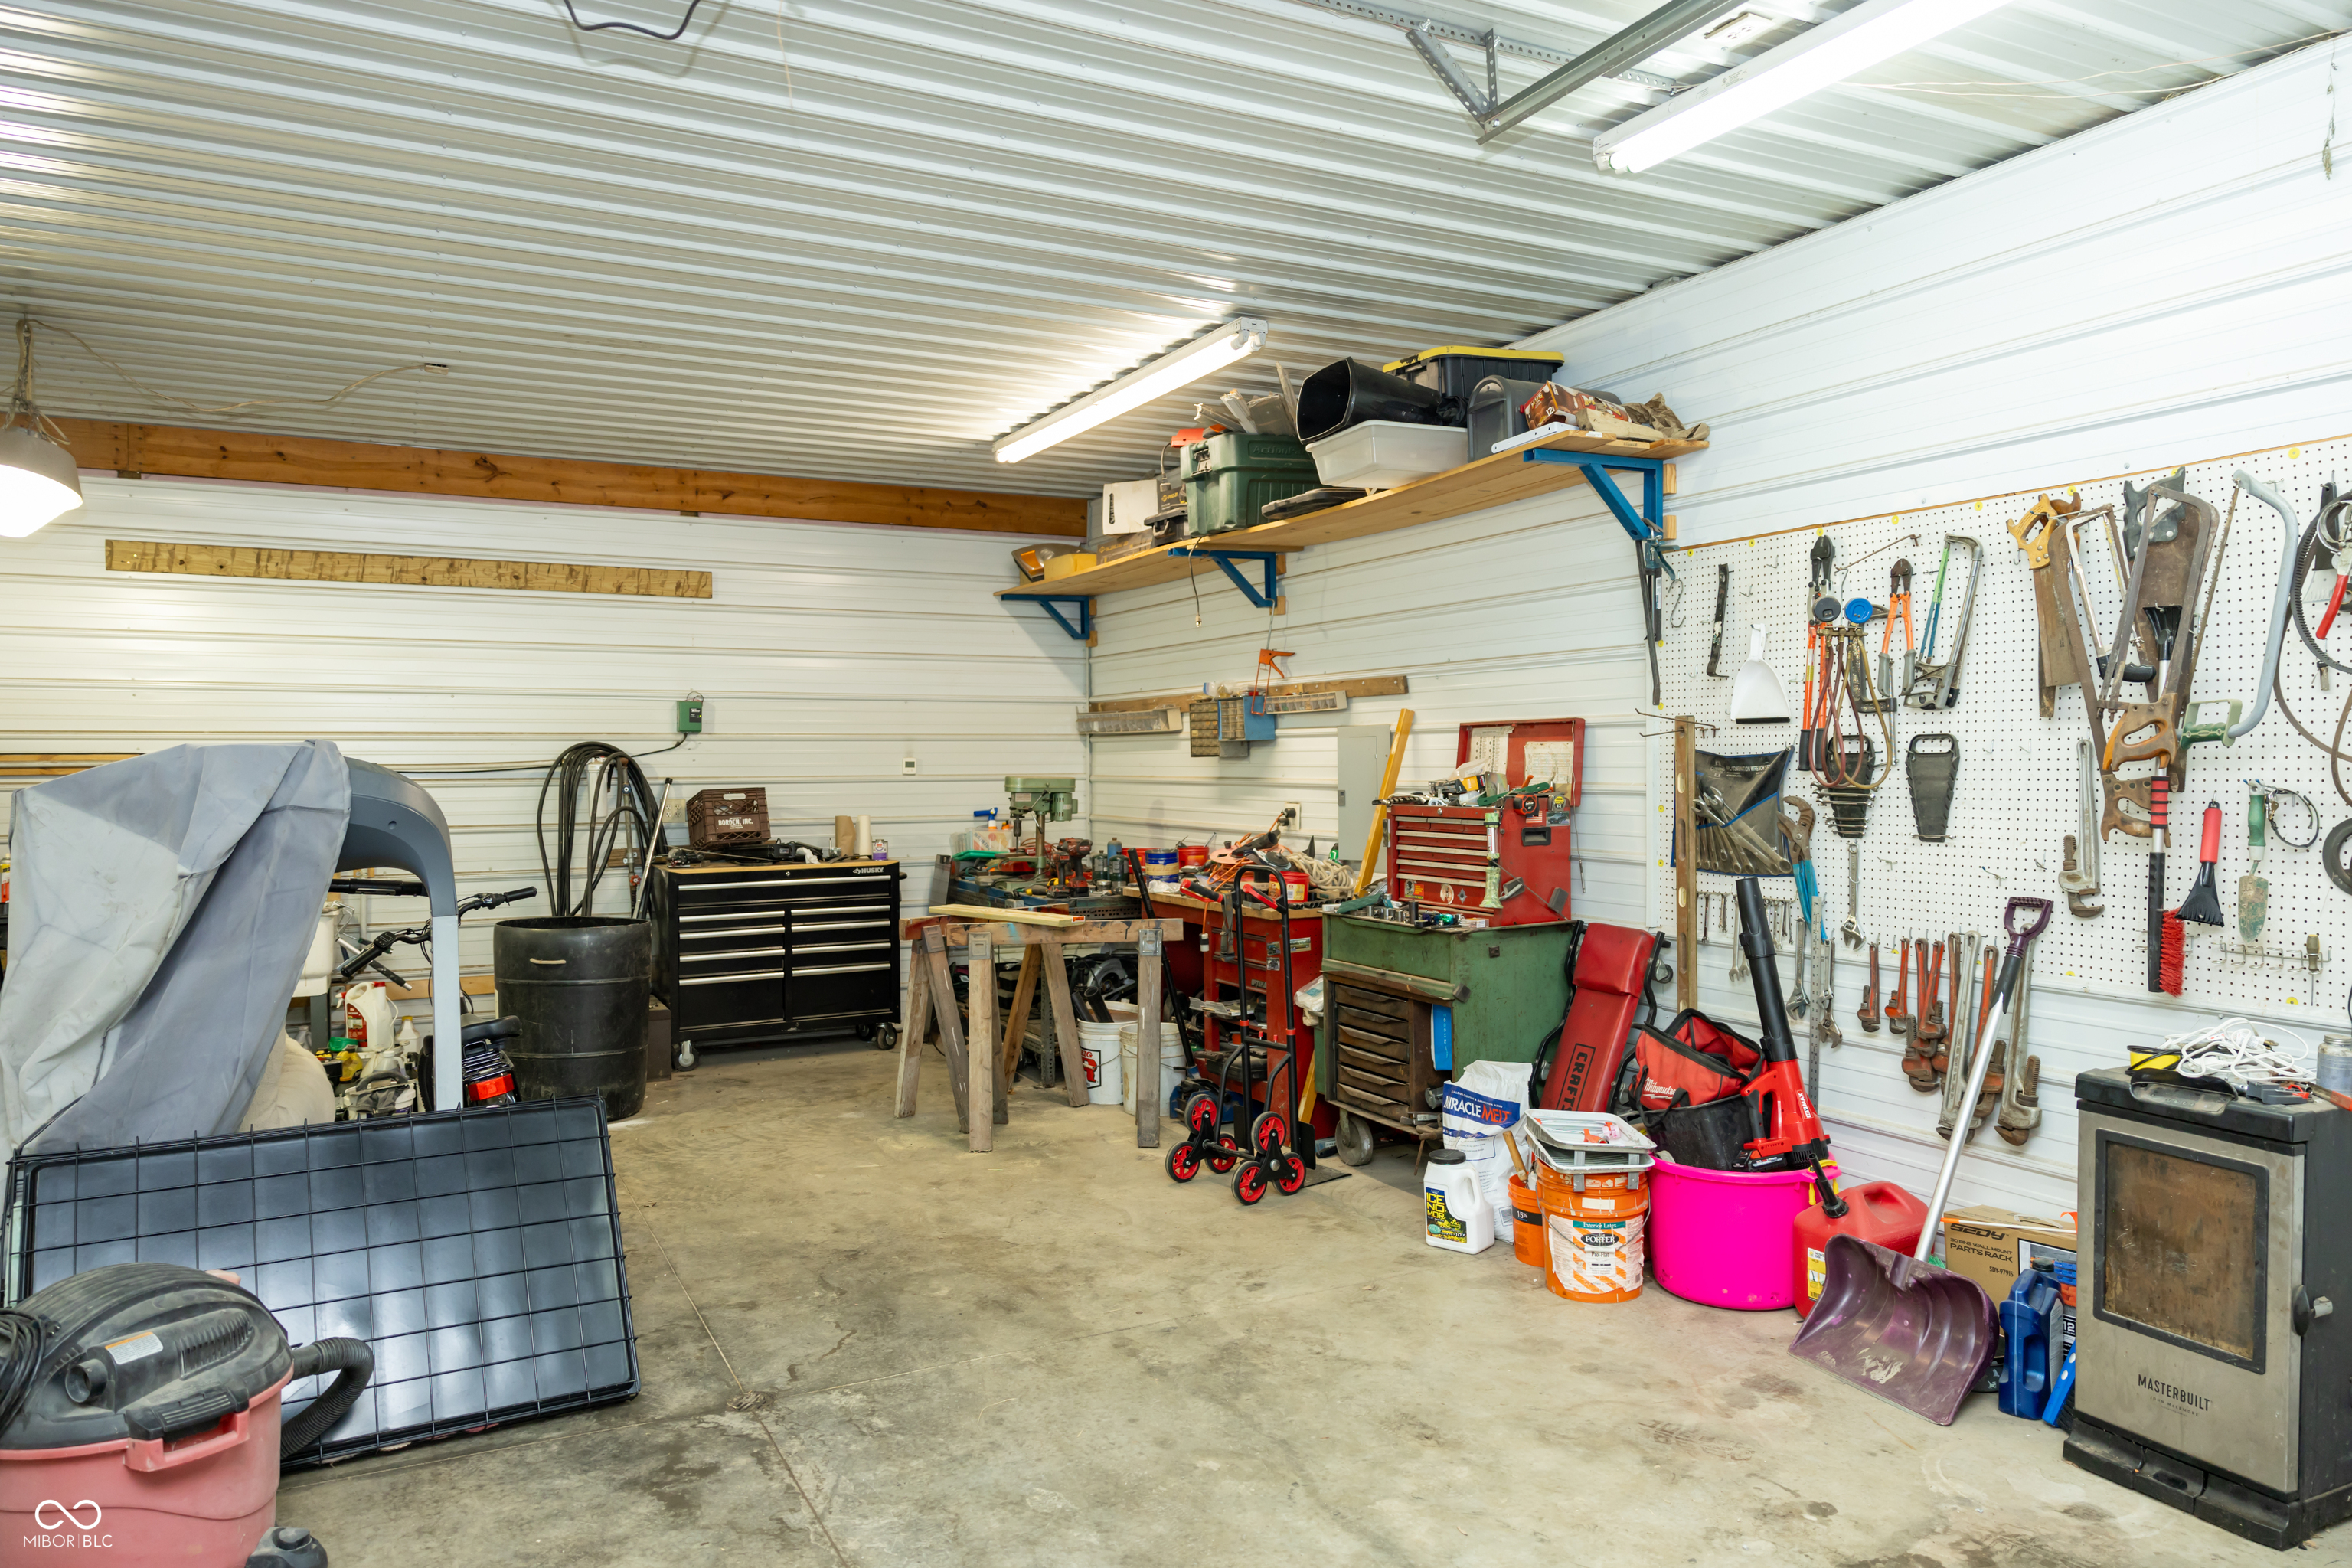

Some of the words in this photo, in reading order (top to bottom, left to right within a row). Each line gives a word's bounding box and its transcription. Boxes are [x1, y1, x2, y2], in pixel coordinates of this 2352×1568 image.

[1798, 1093, 1807, 1107] MAX
[1443, 1096, 1481, 1118] MIRACLE
[1481, 1104, 1510, 1123] MELT
[1426, 1192, 1445, 1205] ICE
[1426, 1202, 1445, 1213] NO
[1517, 1210, 1528, 1219] 15%
[1950, 1223, 2006, 1241] SEDY
[1950, 1243, 1983, 1256] PARTS
[1984, 1252, 2013, 1263] RACK
[1972, 1242, 1991, 1250] WALL
[1991, 1246, 2013, 1256] MOUNT
[1989, 1266, 2014, 1277] SDY-97915
[2063, 1321, 2075, 1333] 12
[2138, 1374, 2210, 1412] MASTERBUILT
